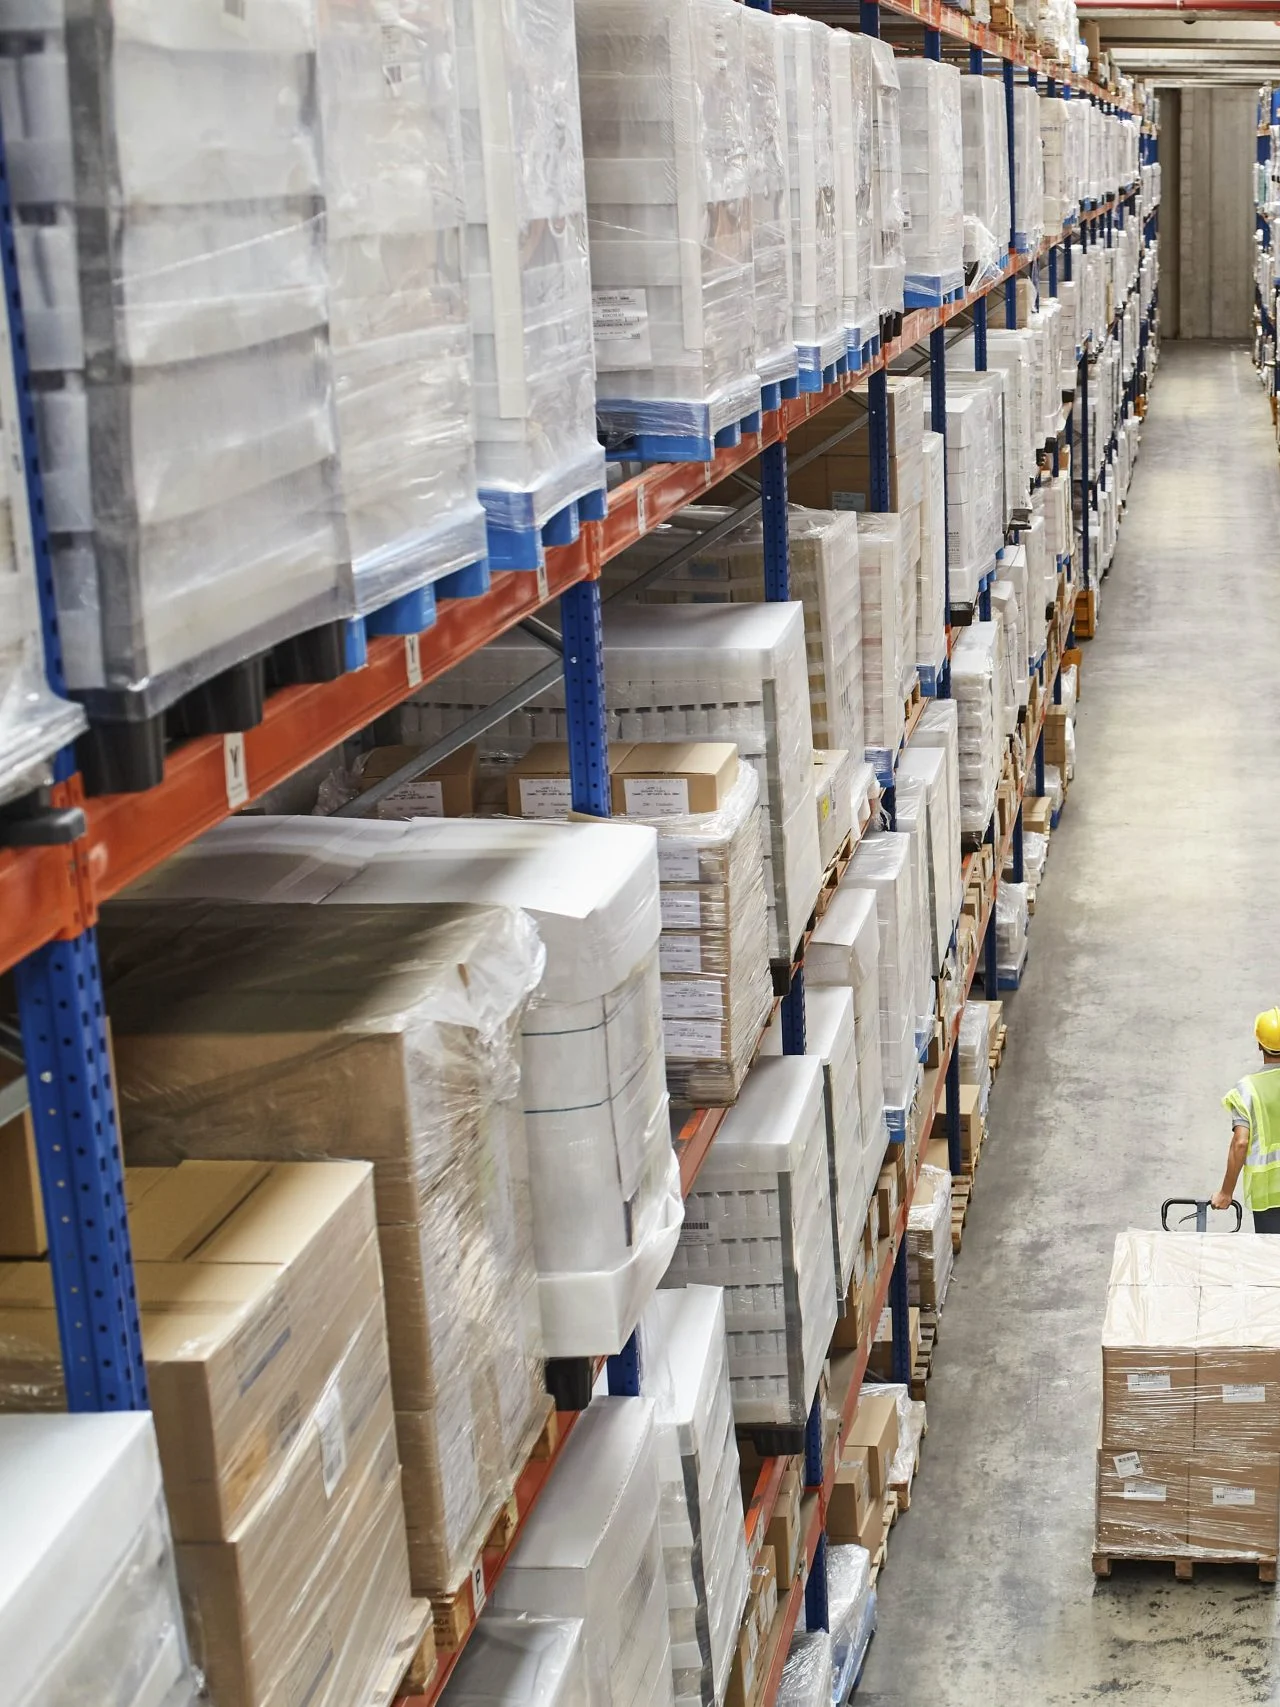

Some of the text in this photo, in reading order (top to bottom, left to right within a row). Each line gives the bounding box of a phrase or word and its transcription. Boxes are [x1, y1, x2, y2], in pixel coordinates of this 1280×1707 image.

[408, 636, 416, 663] Y
[229, 745, 240, 778] Y
[475, 1568, 481, 1595] P
